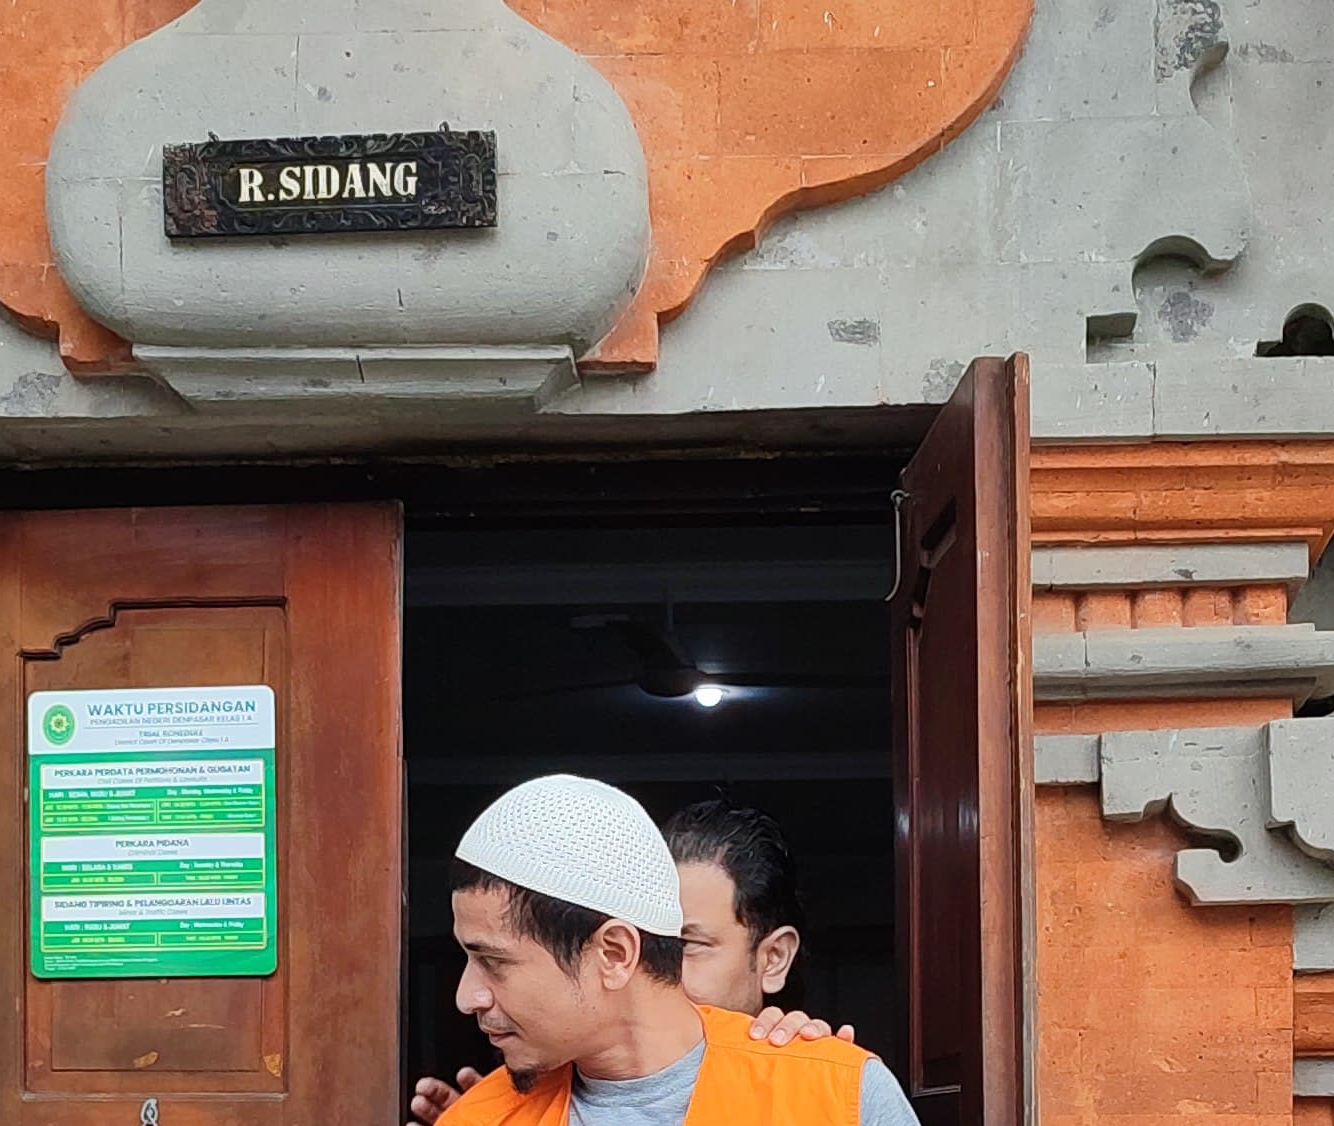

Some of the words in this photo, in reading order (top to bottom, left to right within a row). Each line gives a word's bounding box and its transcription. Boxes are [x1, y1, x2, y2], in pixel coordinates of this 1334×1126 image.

[238, 161, 418, 203] R.SIDANG
[87, 703, 144, 717] WAKTU
[148, 700, 256, 715] PERSIDANGAN
